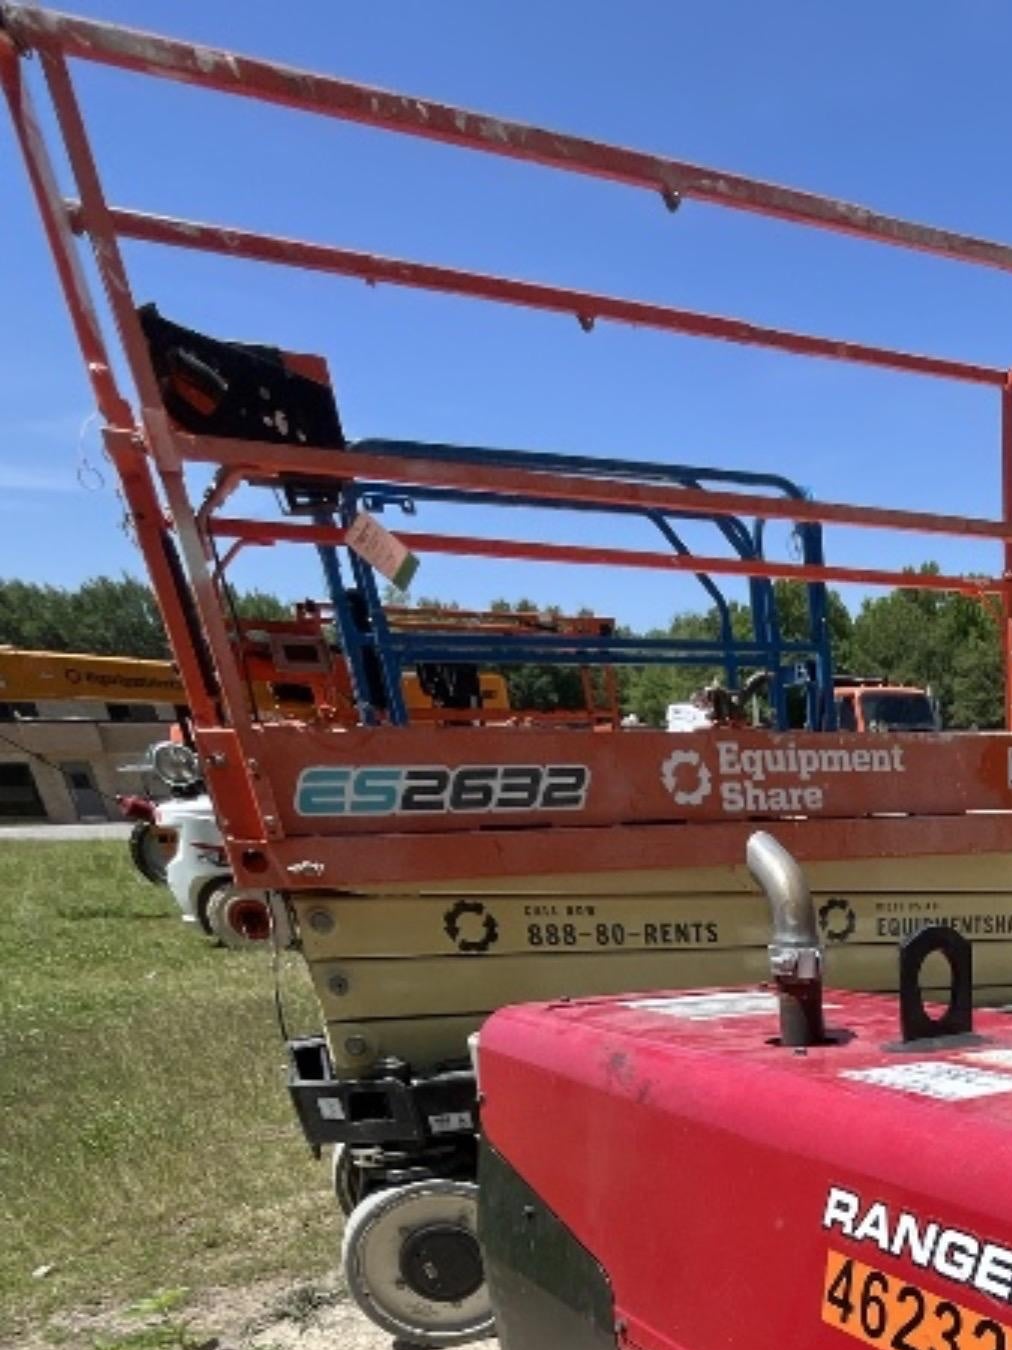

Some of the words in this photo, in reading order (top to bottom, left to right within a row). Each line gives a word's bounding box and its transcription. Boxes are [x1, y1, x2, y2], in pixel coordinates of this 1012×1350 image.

[717, 741, 906, 776] Equipment
[296, 764, 592, 816] ES2632
[721, 780, 825, 813] Share
[527, 922, 719, 946] 888-80-RENTS
